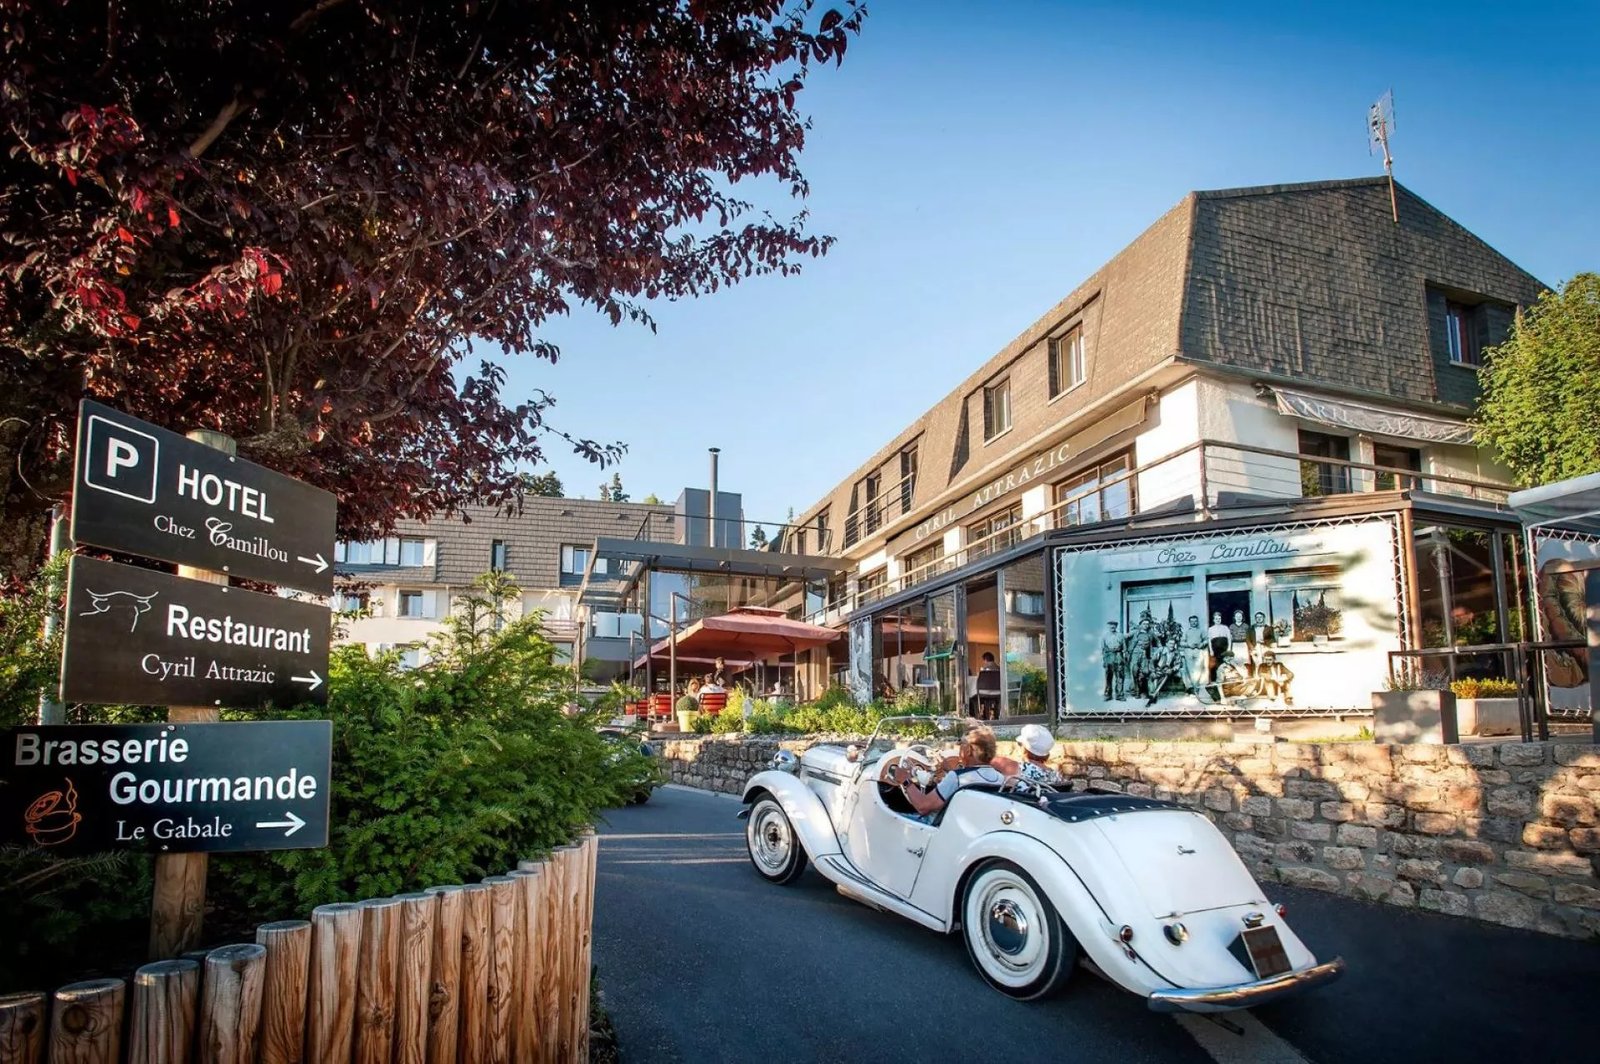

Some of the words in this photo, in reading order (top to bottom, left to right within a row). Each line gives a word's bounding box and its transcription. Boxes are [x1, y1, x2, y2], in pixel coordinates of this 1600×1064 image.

[107, 437, 139, 478] P
[178, 464, 274, 524] HOTEL
[915, 508, 956, 540] CYRIL
[973, 443, 1071, 508] ATTRAZIC
[154, 514, 196, 540] Chez
[205, 517, 289, 563] Camillou
[1157, 548, 1197, 565] Chez
[1210, 538, 1300, 560] Camillou
[167, 603, 311, 654] Restaurant
[141, 653, 196, 681] Cyril
[205, 659, 275, 684] Attrazic
[15, 731, 189, 766] Brasserie
[109, 768, 317, 805] Gourmande
[116, 820, 146, 841] Le
[153, 817, 233, 839] Gabale
